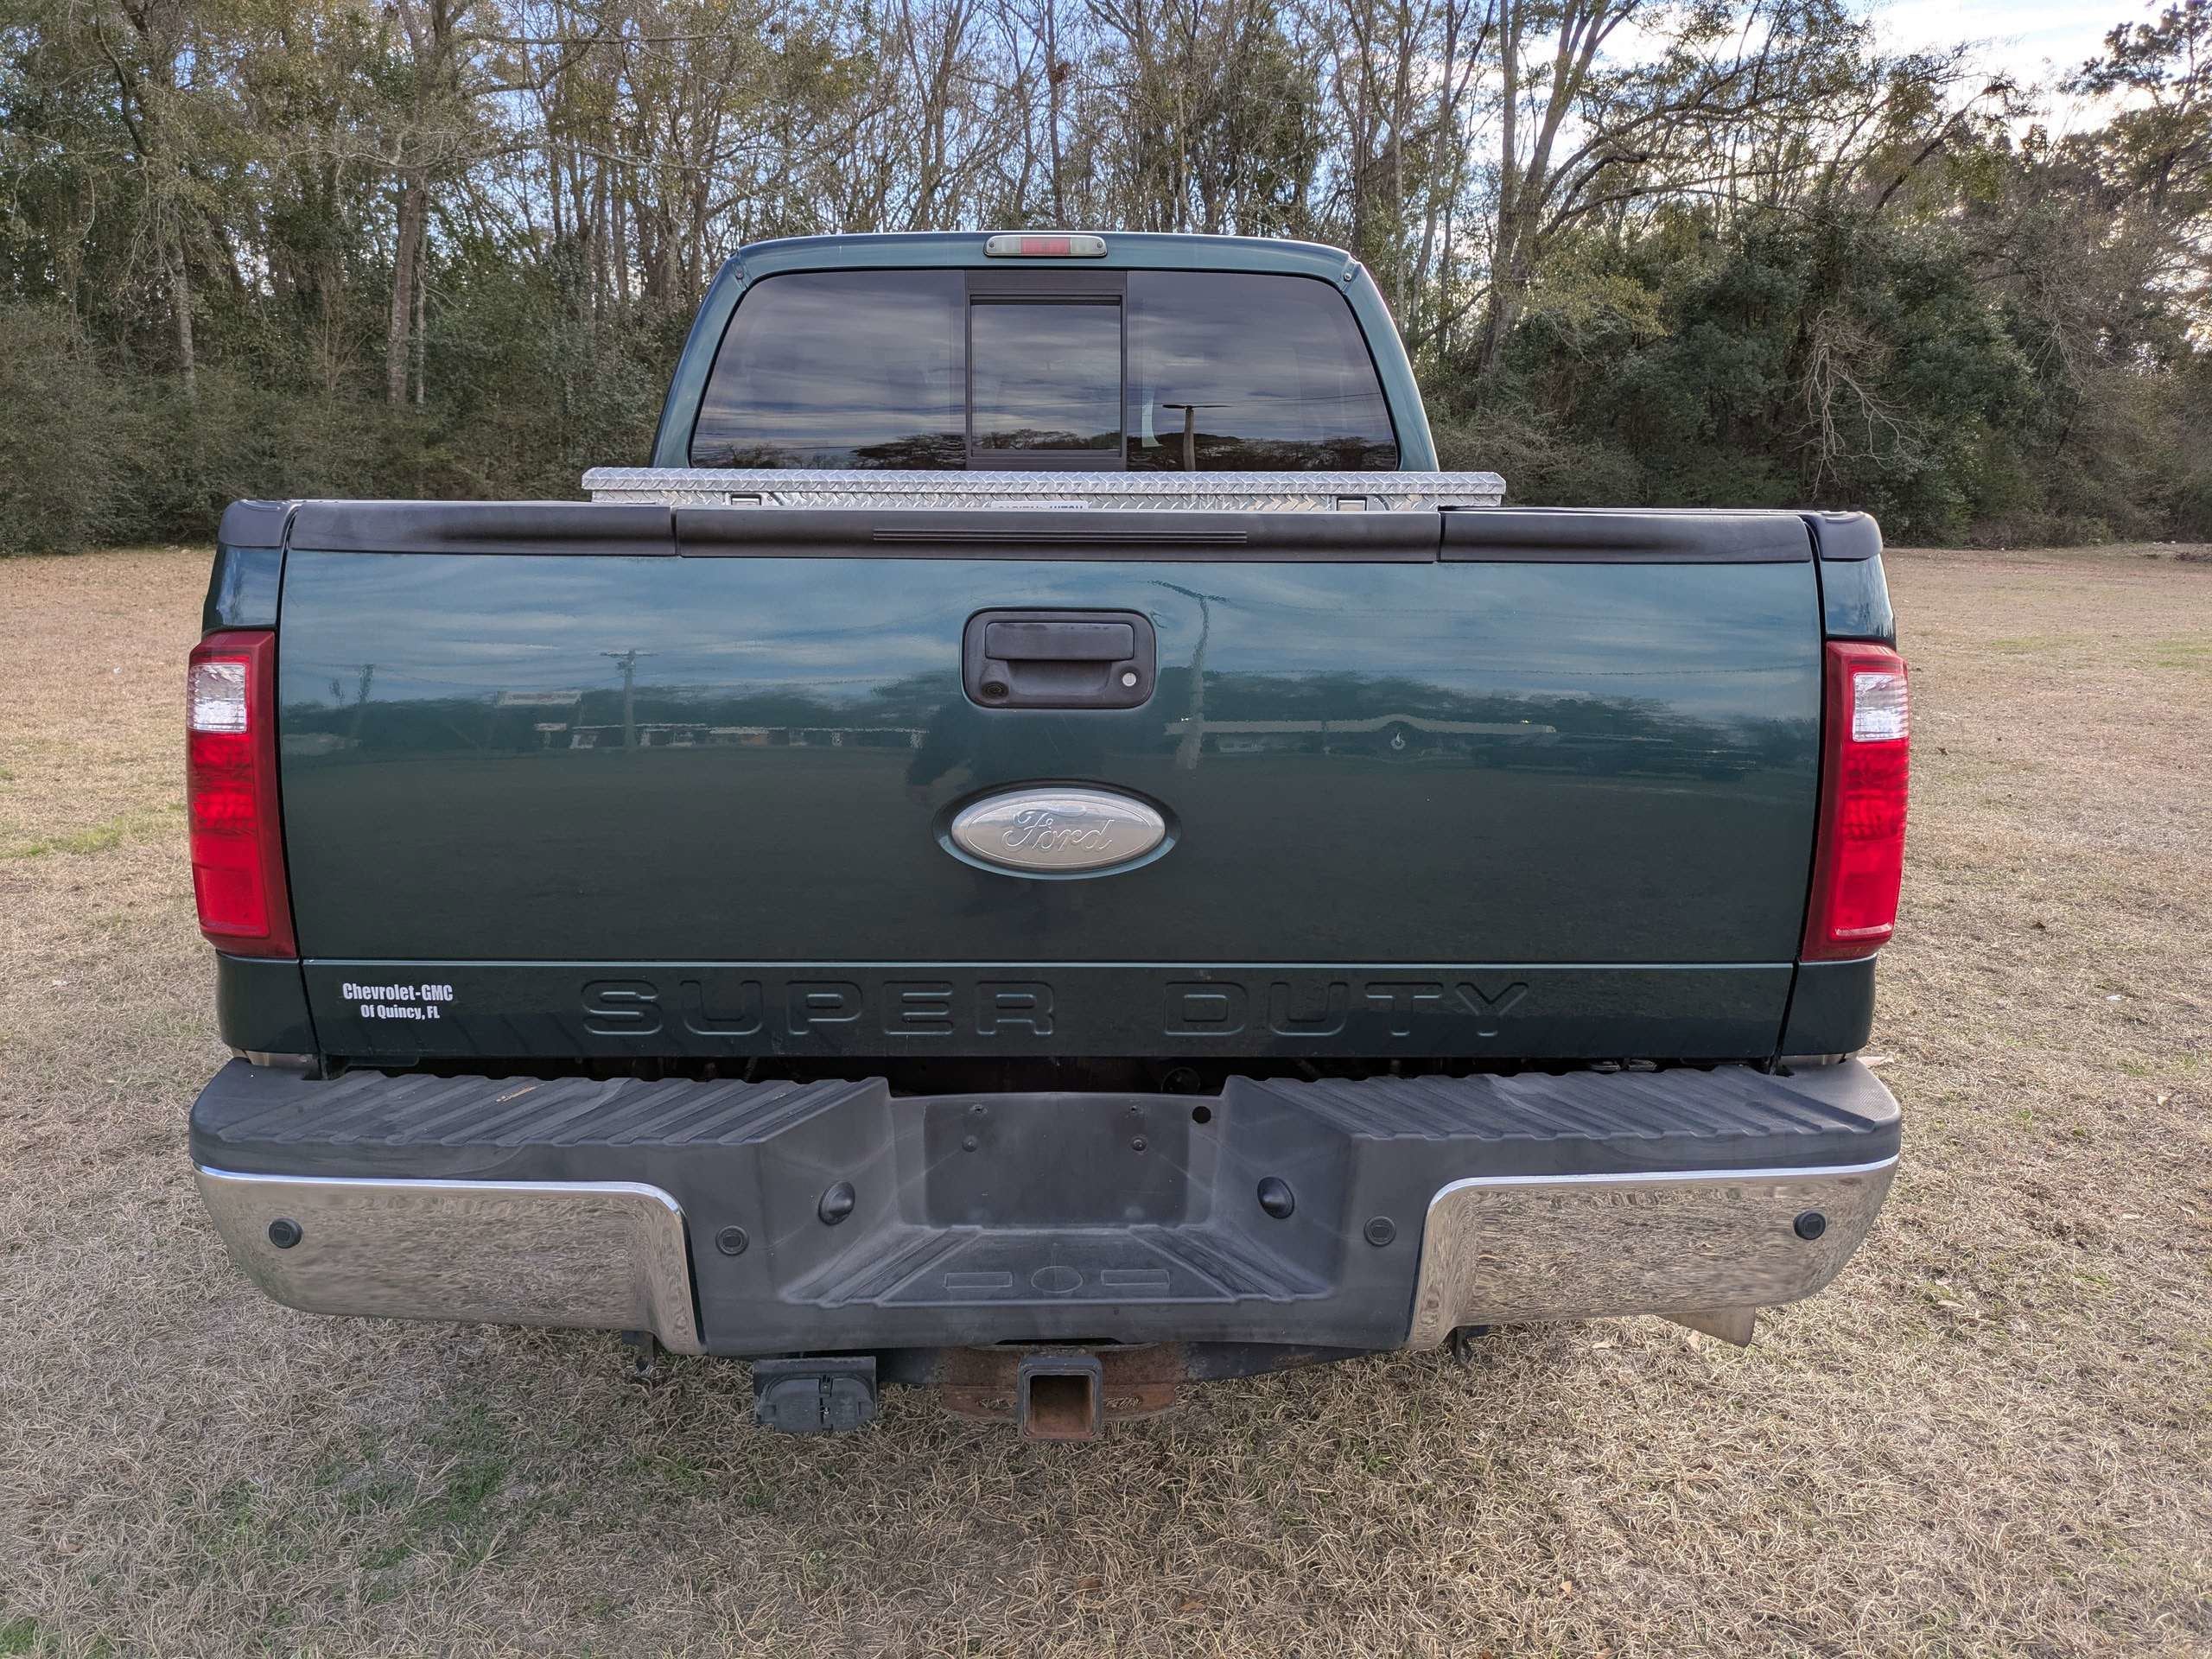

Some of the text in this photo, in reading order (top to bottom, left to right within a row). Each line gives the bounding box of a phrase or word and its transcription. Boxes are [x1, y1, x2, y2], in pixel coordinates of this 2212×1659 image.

[1001, 804, 1115, 852] Ford
[342, 982, 454, 1001] Chevrolet-GMC
[581, 979, 1529, 1036] SUPER DUTY
[360, 1004, 441, 1020] Of Quincy, FL
